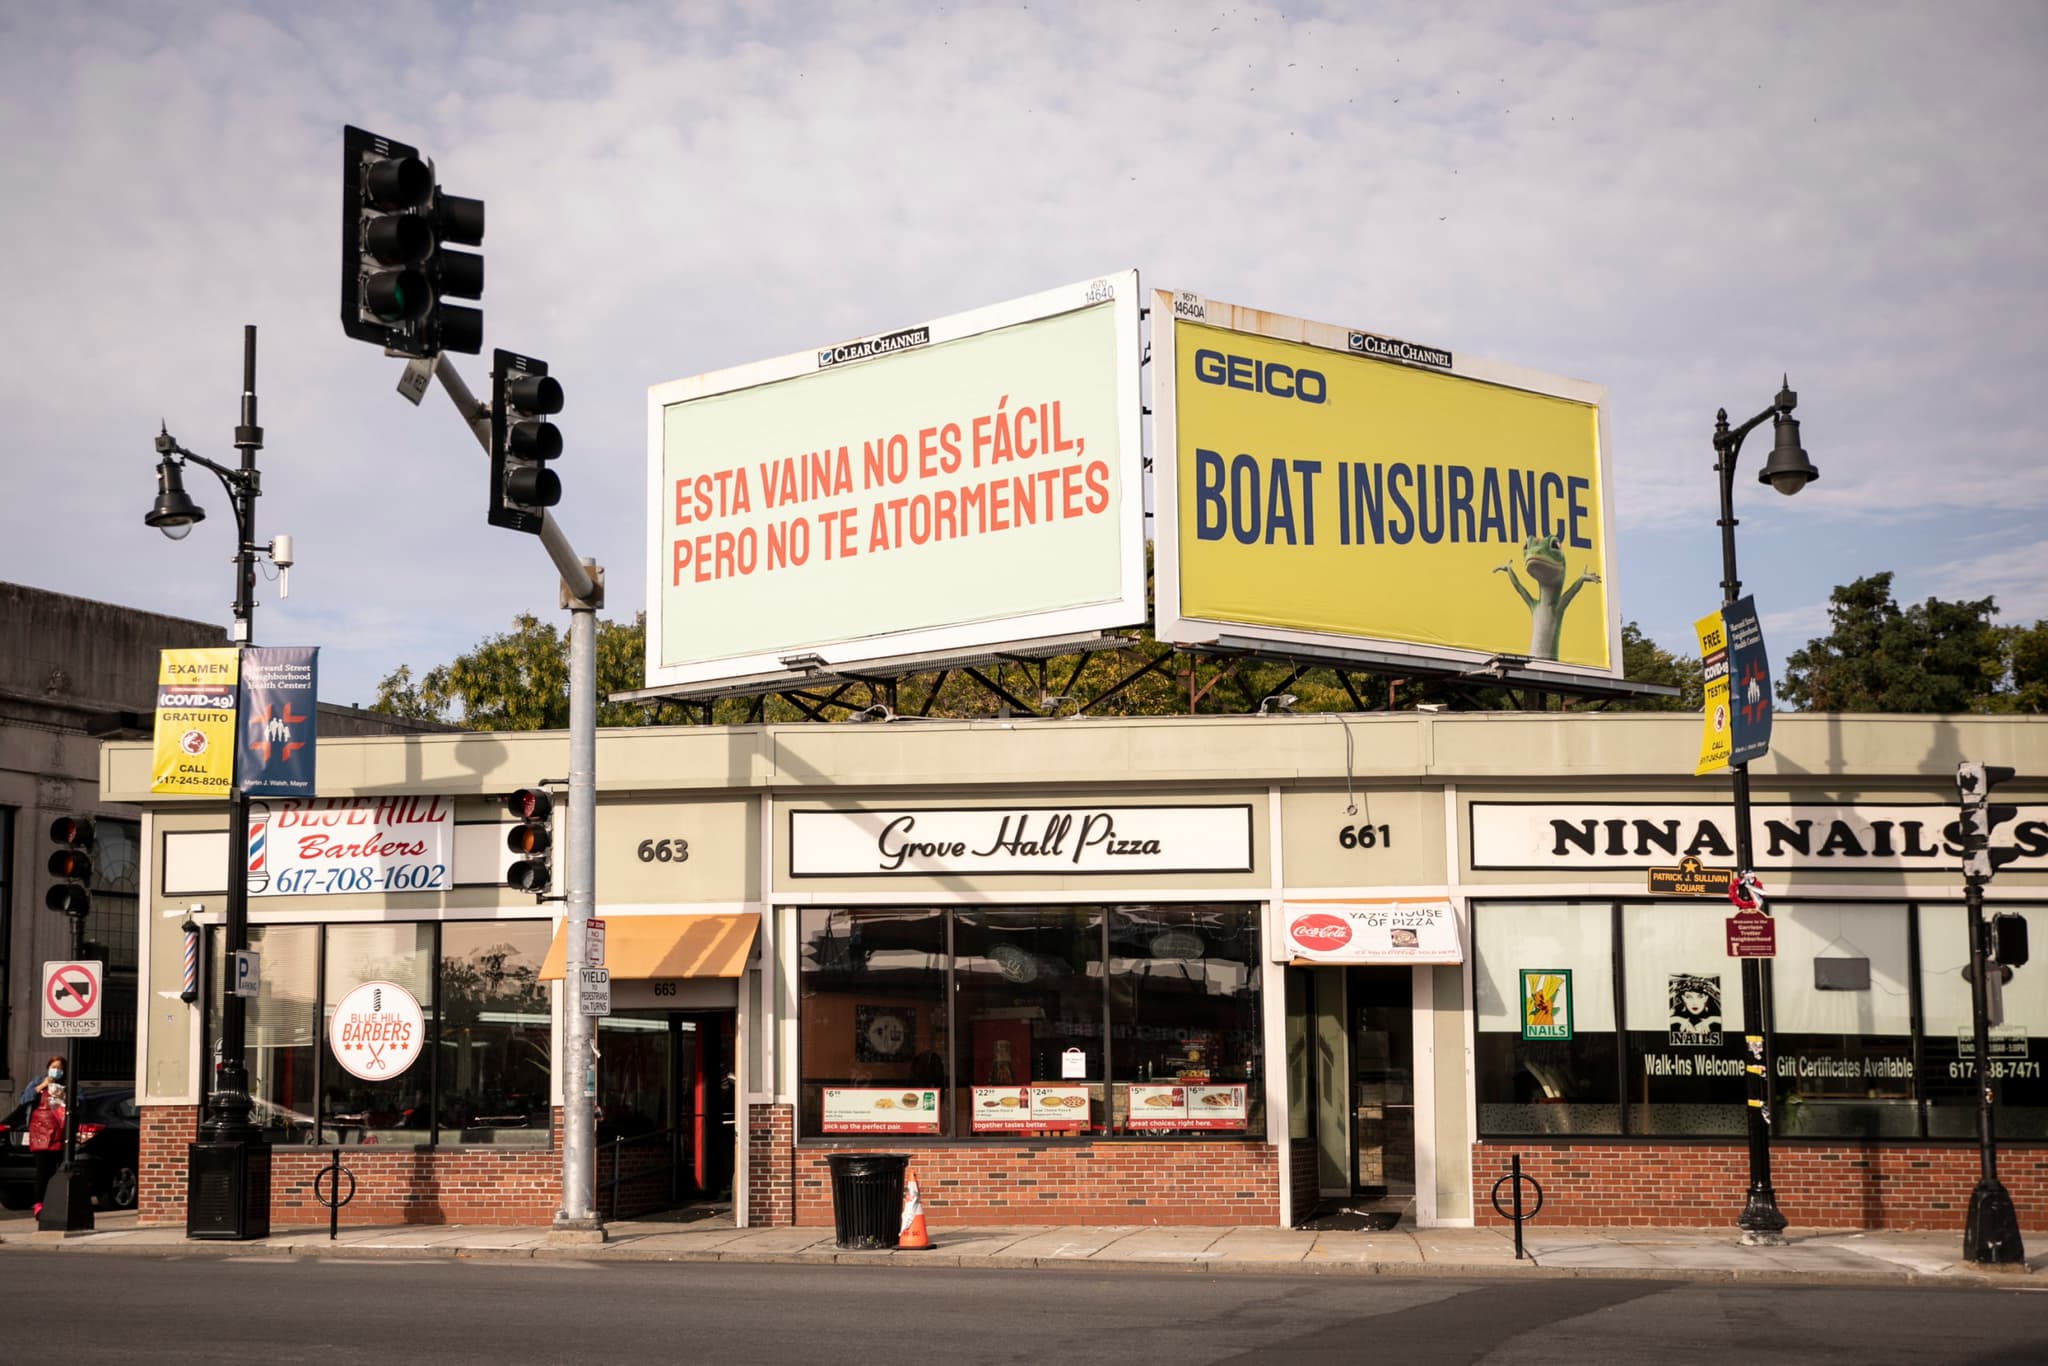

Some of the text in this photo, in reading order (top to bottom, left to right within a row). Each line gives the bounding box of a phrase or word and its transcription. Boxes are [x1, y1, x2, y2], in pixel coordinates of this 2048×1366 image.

[1085, 285, 1114, 302] 14640
[1182, 292, 1197, 302] 1671
[1174, 301, 1205, 318] 14640A
[1194, 348, 1327, 405] GEICO
[675, 394, 1086, 526] ESTA VAINA NO ES FÁCIL,
[1196, 448, 1593, 550] BOAT INSURANCE
[673, 460, 1110, 587] PERO NO TE ATORMENTES
[1703, 630, 1721, 651] FREE
[168, 663, 229, 674] EXAMEN
[284, 664, 311, 672] Street
[160, 694, 235, 709] (COVID-19)
[162, 712, 229, 723] GRATUITO
[179, 764, 207, 774] CALL
[878, 813, 1162, 870] Grove Hall Pizza
[1339, 824, 1391, 850] 661
[1550, 818, 1734, 857] NINA
[297, 832, 429, 860] Barbers
[637, 839, 690, 863] 663
[276, 864, 446, 894] 617-708-1602
[1653, 873, 1682, 882] PATRICK
[1694, 873, 1728, 883] SULLIVAN
[1675, 884, 1706, 893] SQUARE
[1367, 917, 1435, 927] OF PIZZA
[1293, 925, 1348, 938] Coca-Cola
[582, 971, 607, 984] YIELD
[654, 982, 677, 996] 663
[590, 1002, 607, 1012] TURNS
[46, 1020, 96, 1029] NO TRUCKS
[351, 1012, 403, 1024] BLUE HILL
[342, 1022, 412, 1042] BARBERS
[1528, 1026, 1567, 1037] NAILS
[1672, 1032, 1721, 1045] NAILS
[1644, 1053, 1746, 1076] Walk-Ins Welcome
[1776, 1055, 1914, 1078] Gift Certificates Available
[1949, 1061, 2041, 1079] 617-38-7471
[824, 1123, 838, 1131] pick
[840, 1123, 849, 1131] up
[862, 1123, 886, 1131] perfect
[975, 1121, 1003, 1129] together
[1005, 1121, 1024, 1129] tastes
[1130, 1119, 1148, 1127] great
